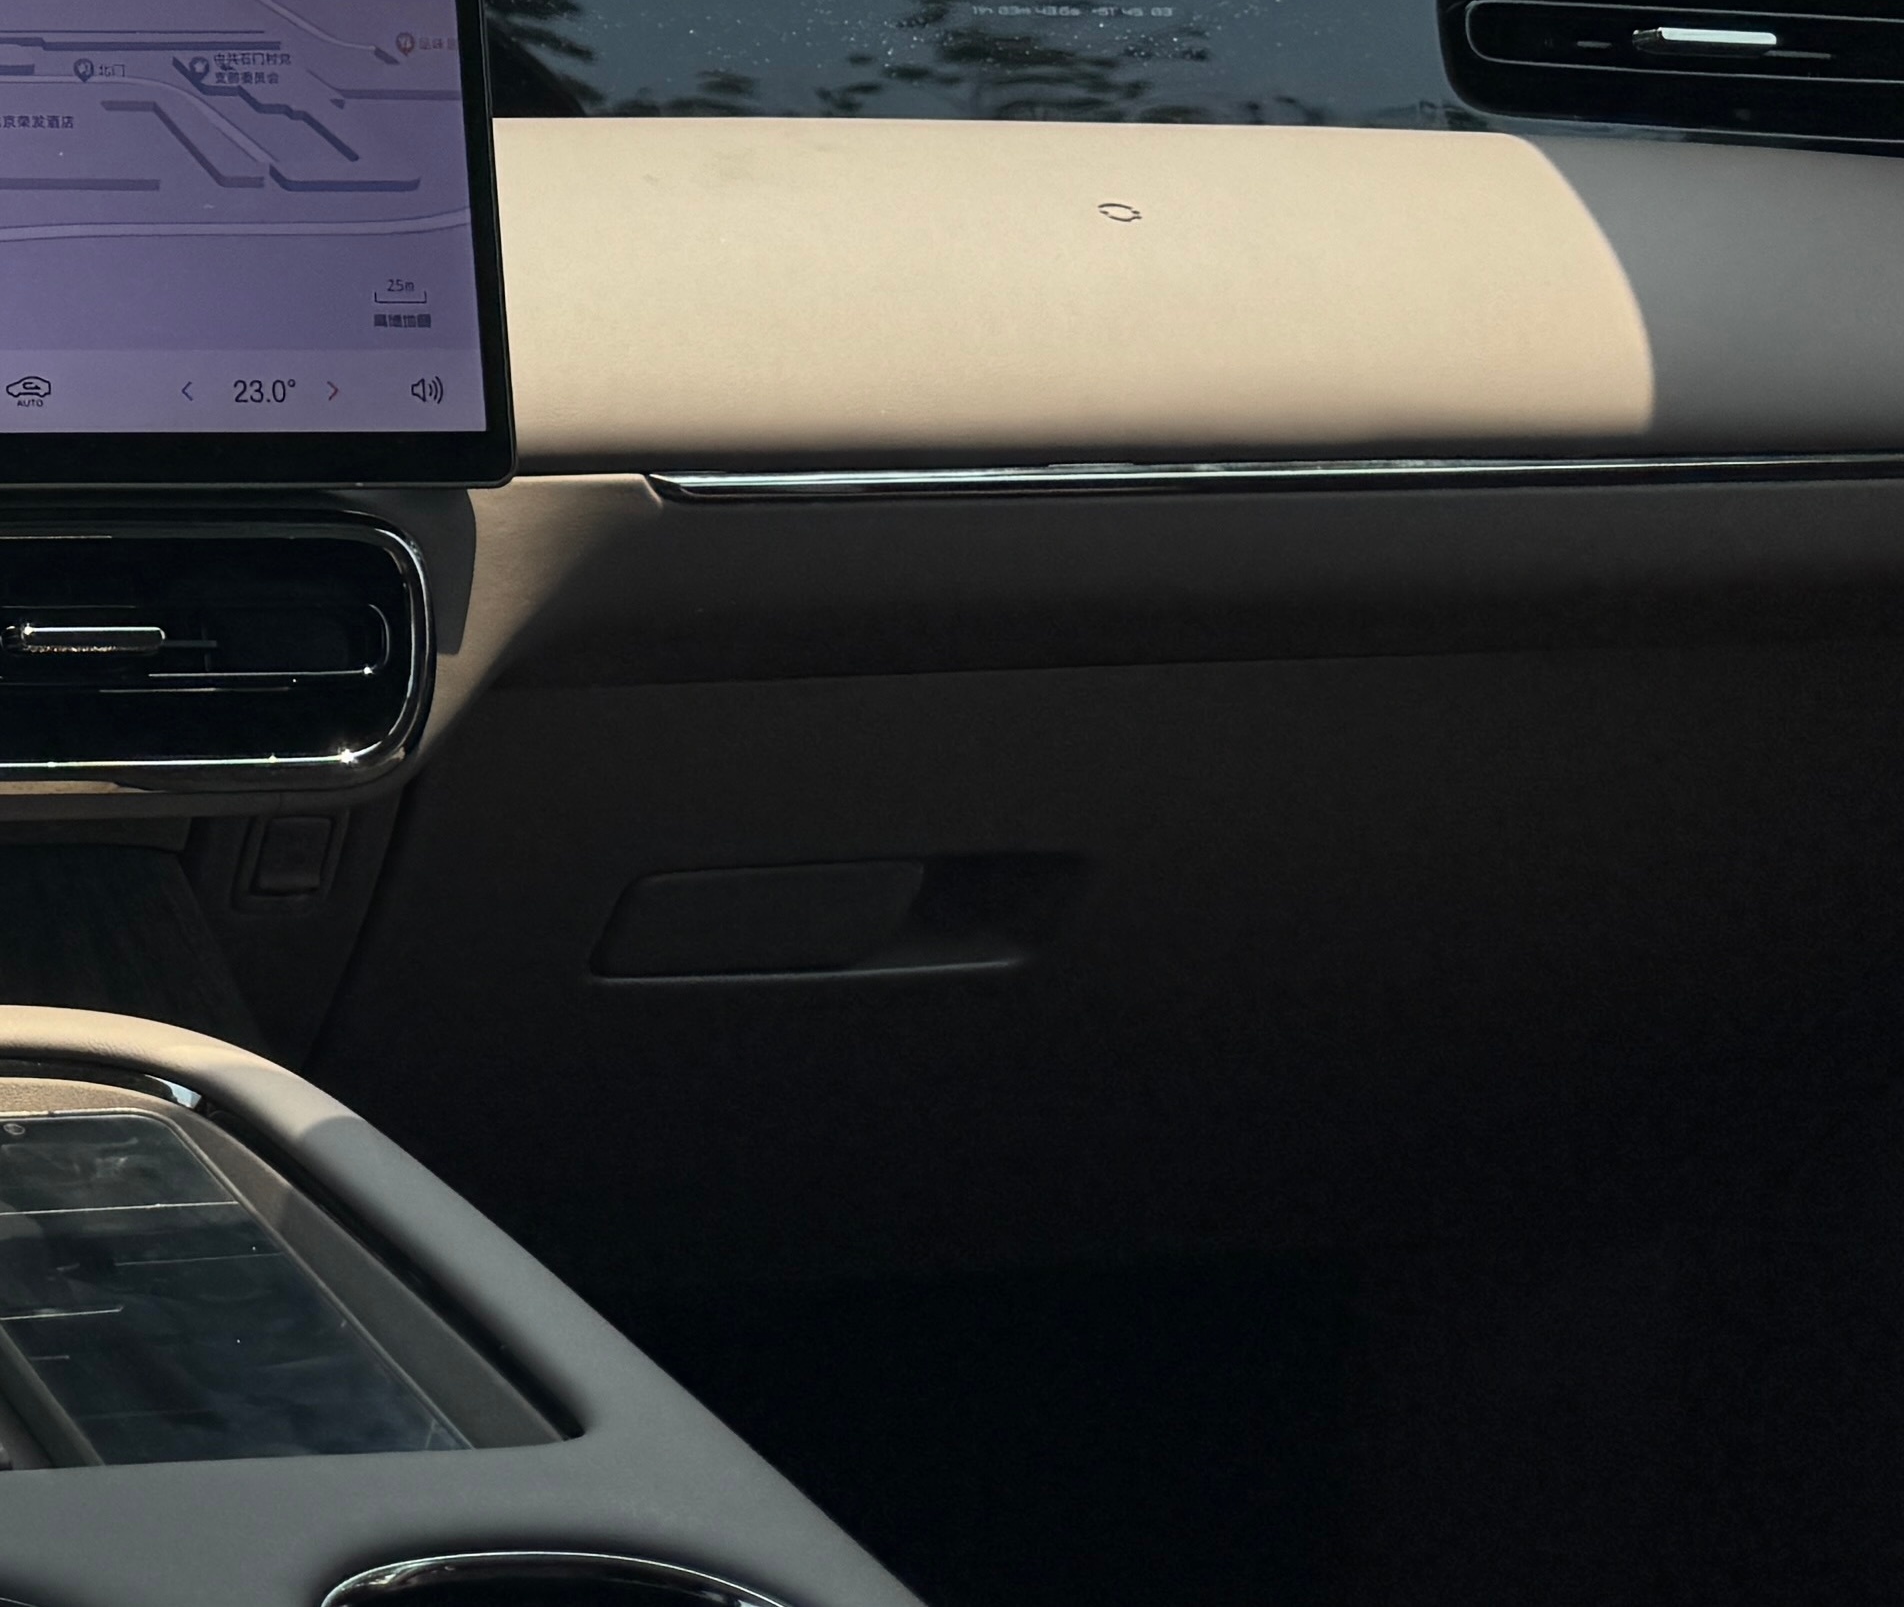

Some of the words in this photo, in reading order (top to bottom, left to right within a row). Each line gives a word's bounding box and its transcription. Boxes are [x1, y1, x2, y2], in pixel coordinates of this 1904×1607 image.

[98, 63, 126, 78] 北门
[233, 379, 296, 404] 23.0°
[16, 399, 44, 408] AUTO
